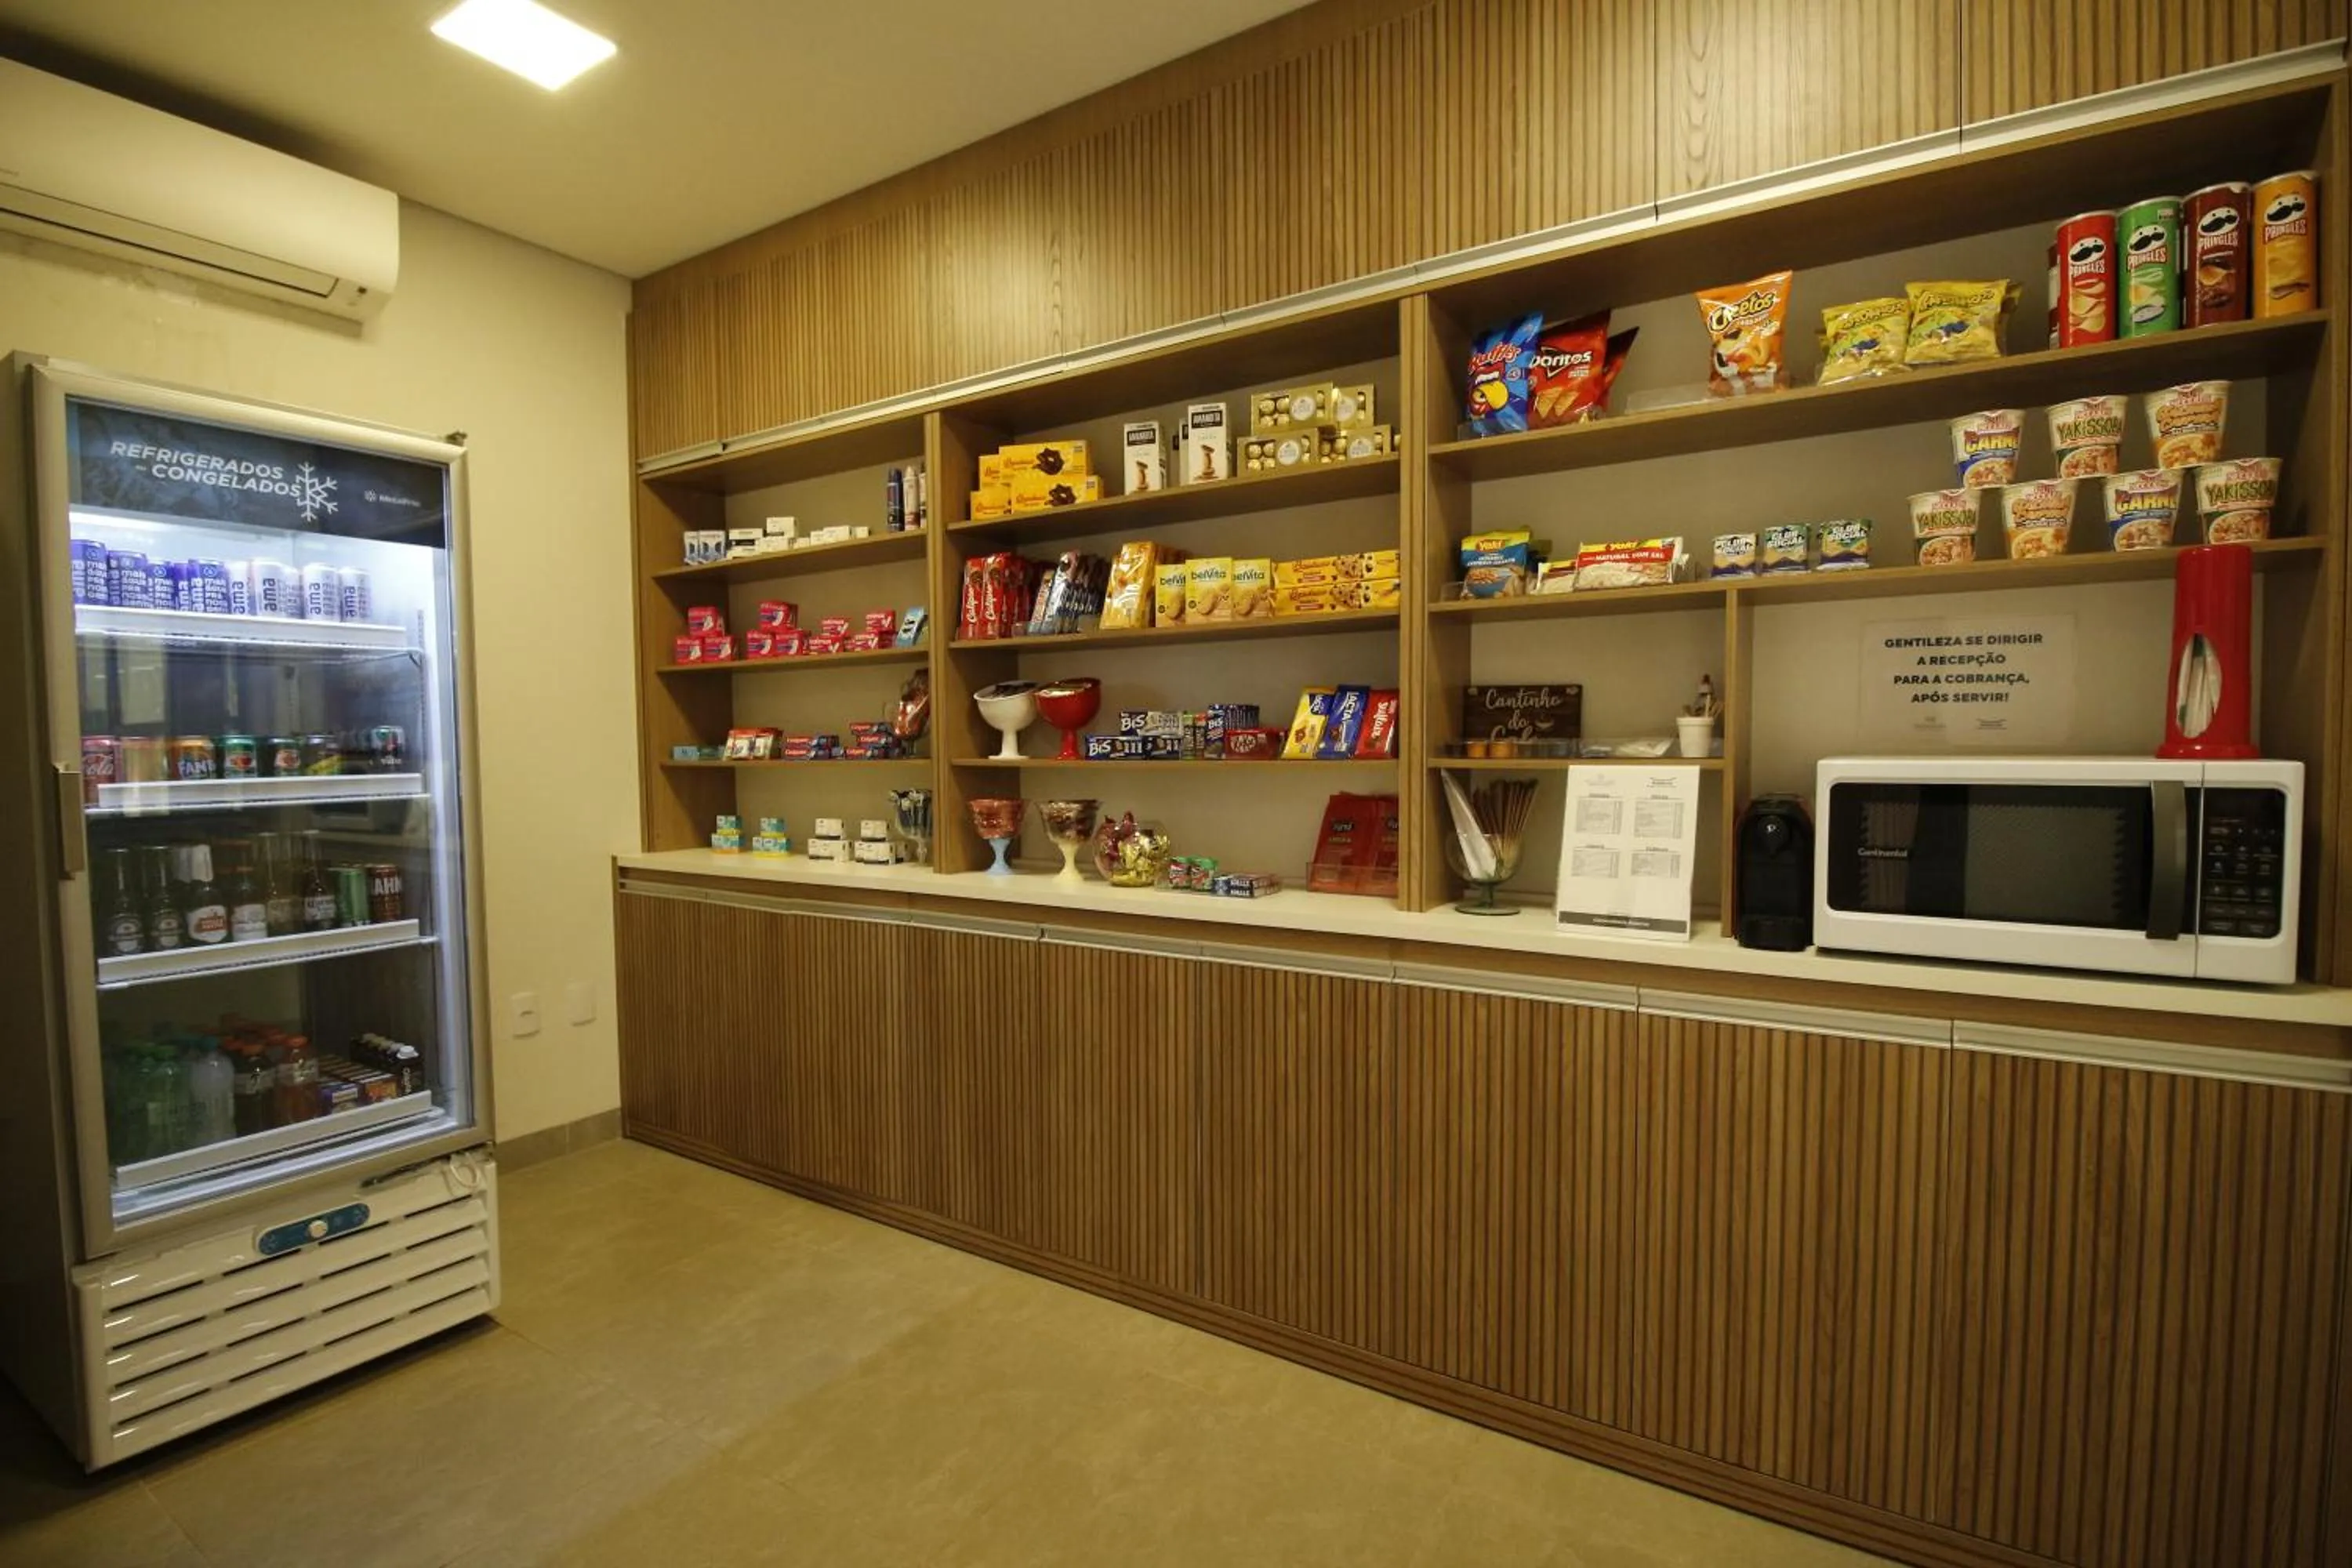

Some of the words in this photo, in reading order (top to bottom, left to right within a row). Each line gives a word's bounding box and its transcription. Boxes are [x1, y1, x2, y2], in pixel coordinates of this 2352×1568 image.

[2127, 247, 2167, 271] PRINGLES
[1709, 291, 1778, 332] Cheetos
[1529, 350, 1593, 368] Doritos
[111, 441, 285, 480] REFRIGERADOS
[151, 464, 302, 498] CONGELADOS
[1160, 573, 1185, 586] belVit
[1191, 567, 1227, 581] belVita
[263, 578, 278, 612] ama
[309, 582, 322, 615] ama
[344, 586, 358, 619] ama
[1885, 636, 1962, 648] GENTILEZA
[1965, 634, 1984, 645] SE
[1987, 633, 2044, 645] DIRIGIR
[1916, 656, 1926, 666] A
[1929, 652, 2007, 667] RECEPÇÃO
[1893, 674, 1930, 684] PARA
[1931, 674, 1942, 684] A
[1944, 673, 2030, 686] COBRANÇA,
[1341, 691, 1360, 721] LACTA
[1485, 687, 1563, 710] Cantinho
[1911, 691, 1950, 703] APÓS
[1951, 691, 2009, 702] SERVIR!
[1857, 848, 1908, 858] Continental
